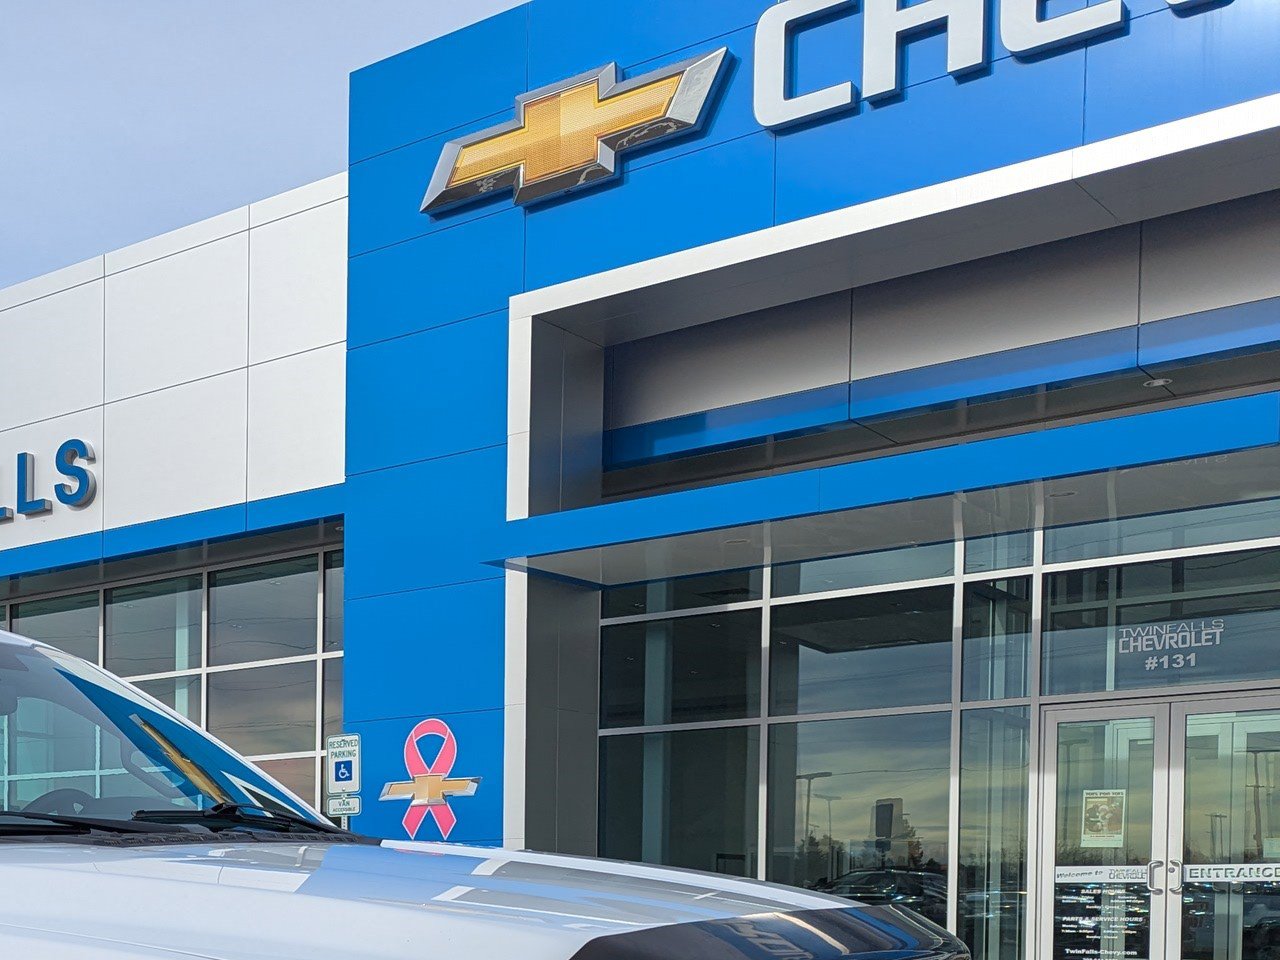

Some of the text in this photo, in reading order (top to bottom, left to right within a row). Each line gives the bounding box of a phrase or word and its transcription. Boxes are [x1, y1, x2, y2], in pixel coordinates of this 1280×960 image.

[1118, 618, 1224, 638] TWINFALLS
[1118, 628, 1224, 653] CHEVROLET
[1145, 652, 1196, 671] #131
[329, 739, 358, 749] RESERVED
[330, 750, 357, 758] PARKING
[338, 799, 350, 807] VAN
[1056, 871, 1093, 879] Welcome
[1108, 872, 1148, 880] CHEVROLE
